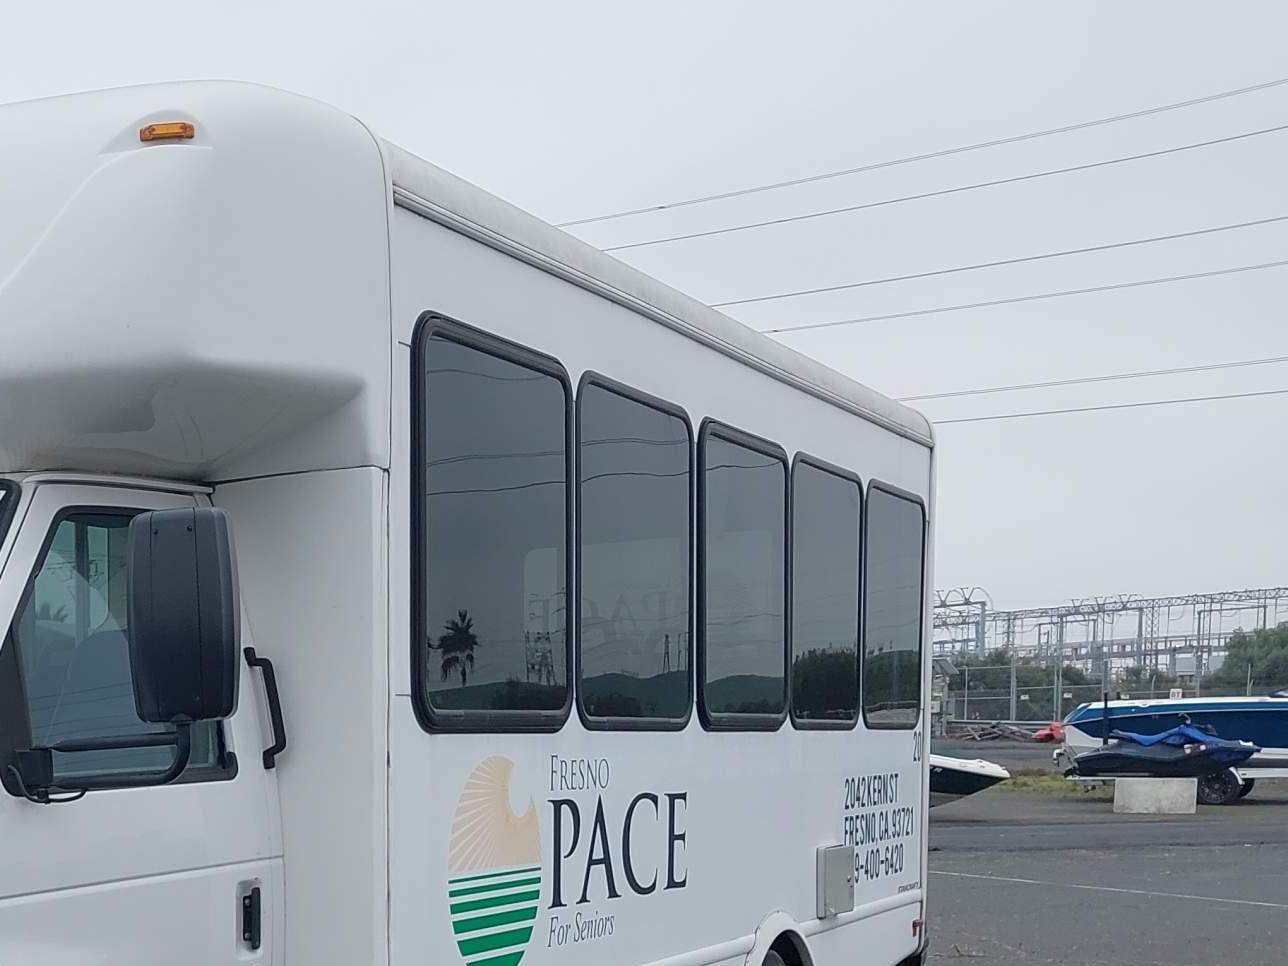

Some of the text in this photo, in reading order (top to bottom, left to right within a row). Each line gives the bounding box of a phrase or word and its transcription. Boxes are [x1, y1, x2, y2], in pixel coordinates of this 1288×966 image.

[913, 731, 921, 762] 20
[550, 755, 610, 791] FRESNO
[547, 792, 688, 910] PACE
[547, 910, 615, 948] For Seniors
